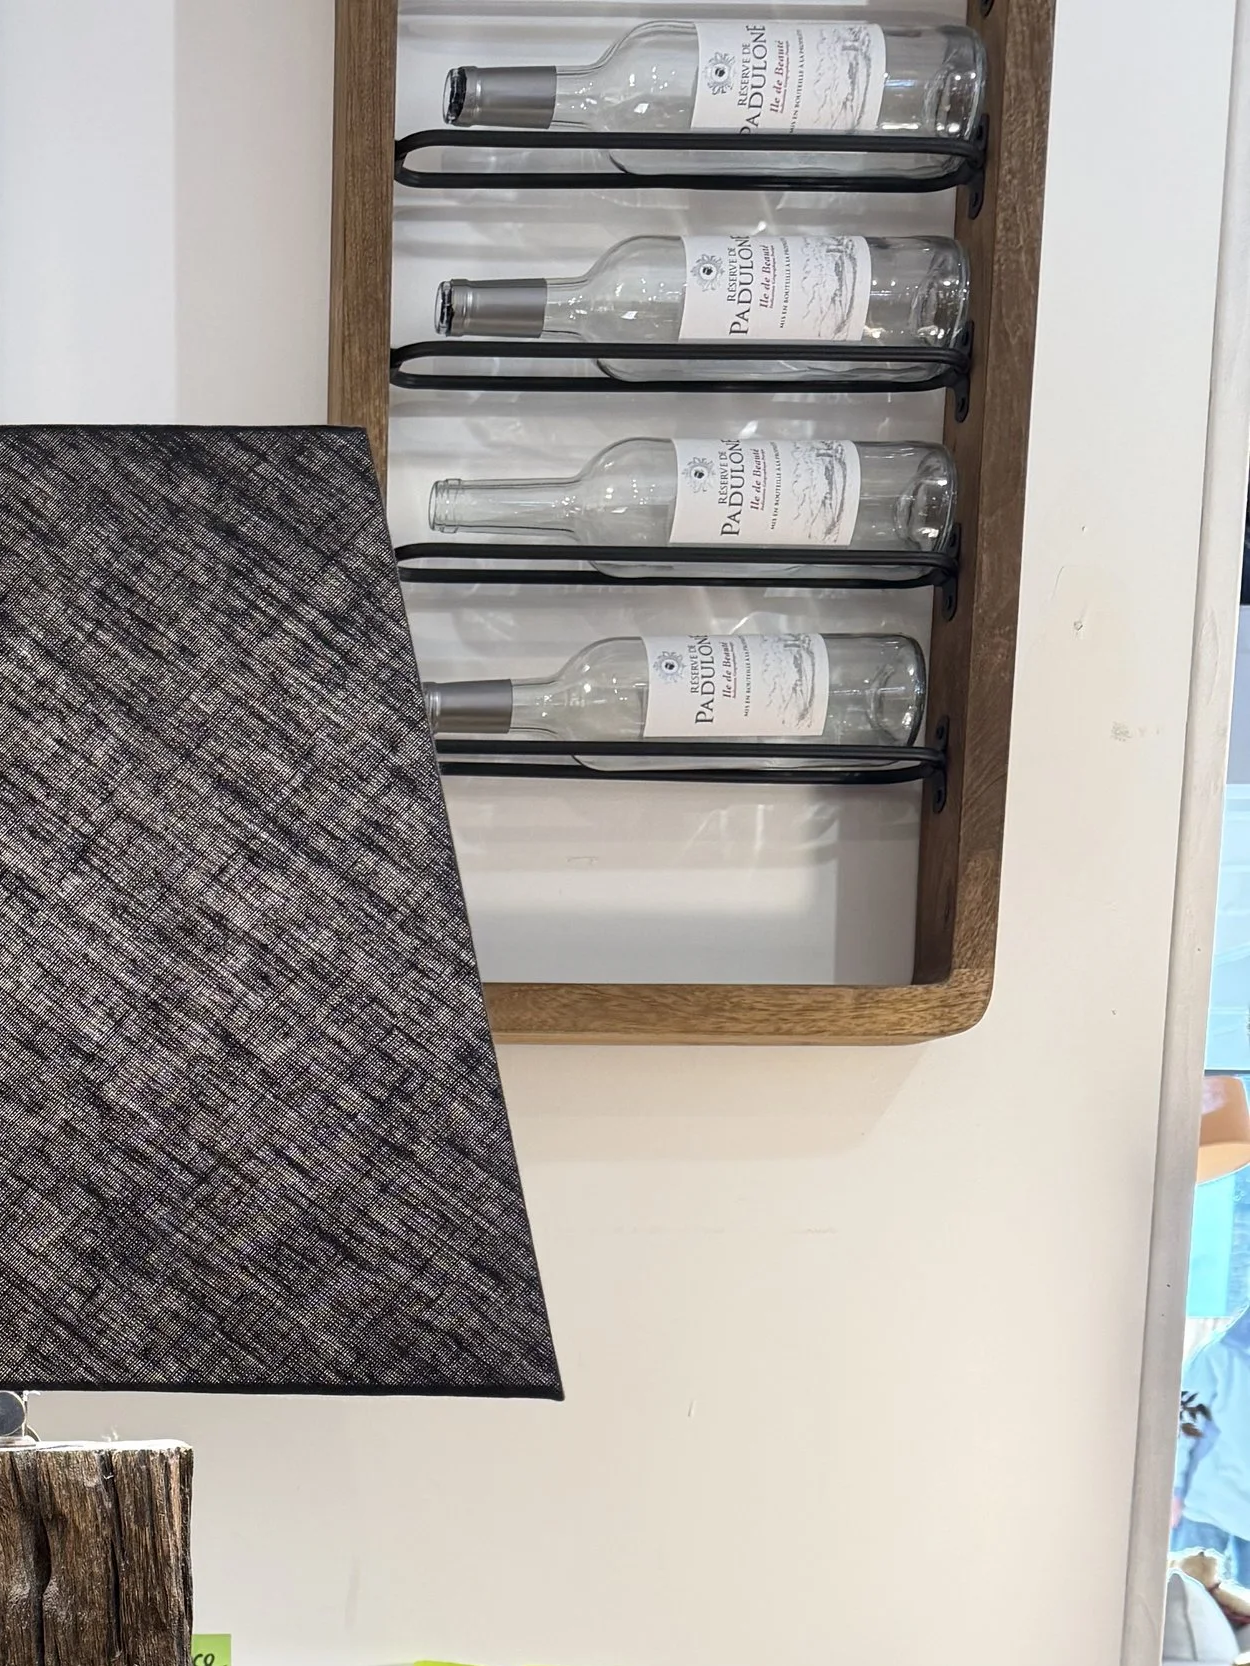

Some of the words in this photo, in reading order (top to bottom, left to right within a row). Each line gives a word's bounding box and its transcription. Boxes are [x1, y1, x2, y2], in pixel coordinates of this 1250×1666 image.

[742, 43, 750, 55] DE
[774, 40, 784, 75] Beauté
[738, 57, 750, 106] RÉSERVE
[773, 80, 782, 94] de
[728, 248, 736, 256] DE
[760, 245, 770, 273] Beauté
[727, 260, 737, 301] RÉSERVE
[761, 278, 770, 290] de
[718, 451, 727, 460] DE
[750, 449, 761, 476] Beauté
[718, 463, 728, 504] RÉSERVE
[752, 480, 761, 493] de
[688, 645, 696, 653] DE
[689, 656, 699, 693] RÉSERVE
[723, 670, 732, 682] de
